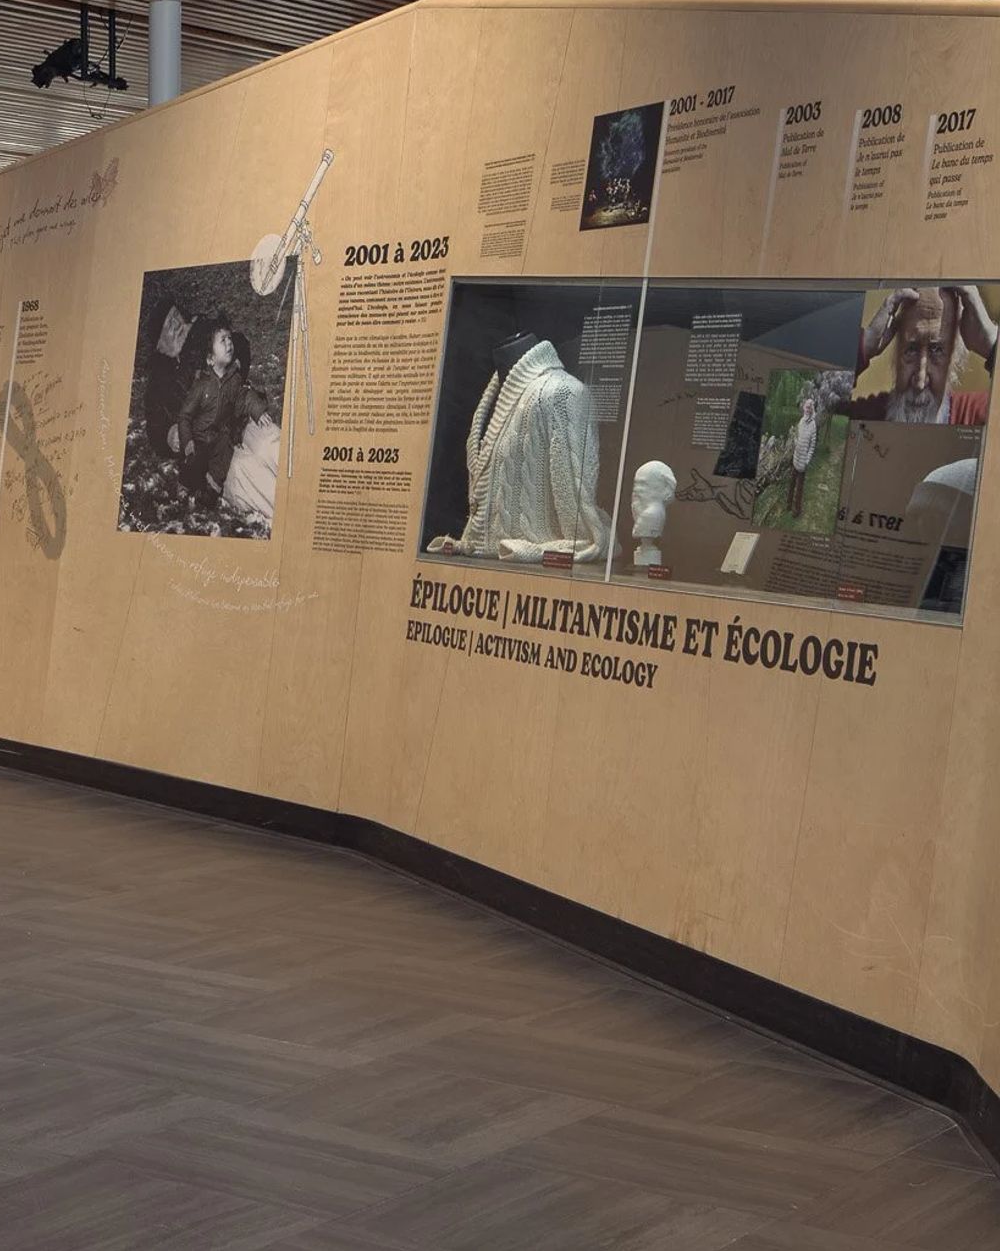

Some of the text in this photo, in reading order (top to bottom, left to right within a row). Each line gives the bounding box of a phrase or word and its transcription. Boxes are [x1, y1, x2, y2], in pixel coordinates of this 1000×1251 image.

[669, 94, 697, 116] 2001
[707, 85, 737, 108] 2017
[786, 101, 822, 125] 2003
[862, 103, 903, 129] 2008
[936, 108, 977, 135] 2017
[782, 128, 824, 143] Publication de
[859, 132, 906, 148] Publication de
[933, 137, 985, 154] Publication de
[931, 153, 994, 171] Le banc du temps
[929, 173, 962, 188] qui passe
[344, 242, 390, 267] 2001
[394, 241, 405, 264] à
[409, 235, 450, 262] 2023
[22, 300, 40, 312] 1968
[322, 446, 400, 463] 2001 à 2023
[409, 573, 501, 623] ÉPILOGUE
[512, 592, 677, 652] MILITANTISME
[683, 618, 719, 658] ET
[725, 615, 879, 687] ÉCOLOGIE
[406, 619, 468, 651] EPILOGUE
[474, 634, 542, 667] ACTIVISM
[543, 645, 578, 674] AND
[580, 654, 660, 689] ECOLOGY
